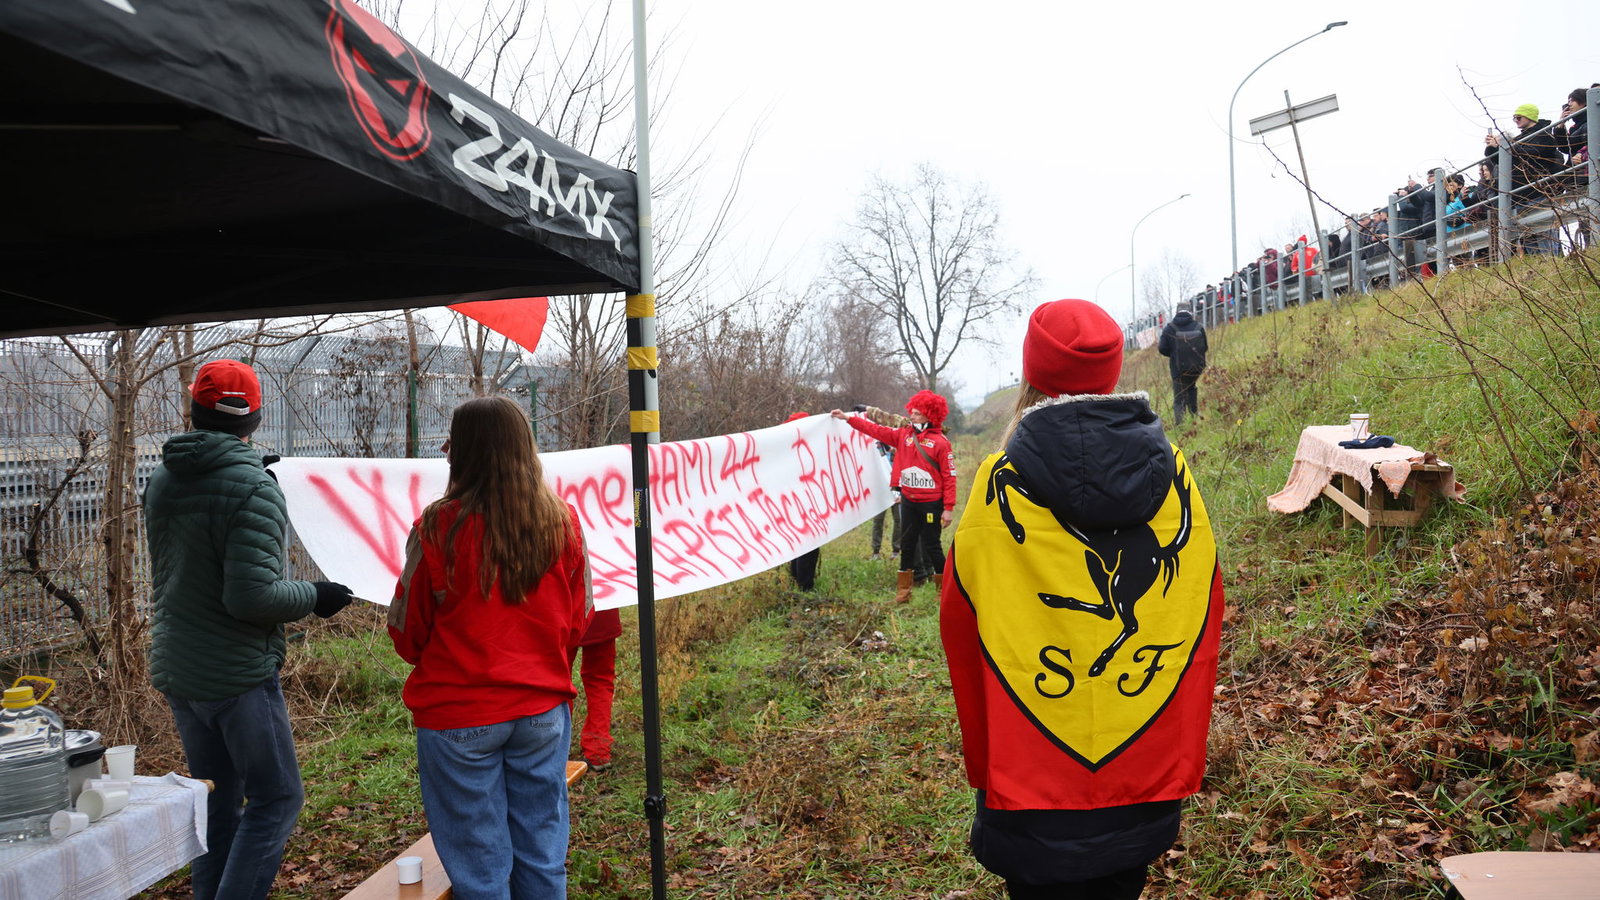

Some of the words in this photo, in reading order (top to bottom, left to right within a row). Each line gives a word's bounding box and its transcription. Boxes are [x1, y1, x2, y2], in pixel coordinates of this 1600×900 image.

[720, 432, 760, 491] 44
[1035, 645, 1075, 698] S
[1117, 639, 1186, 697] F
